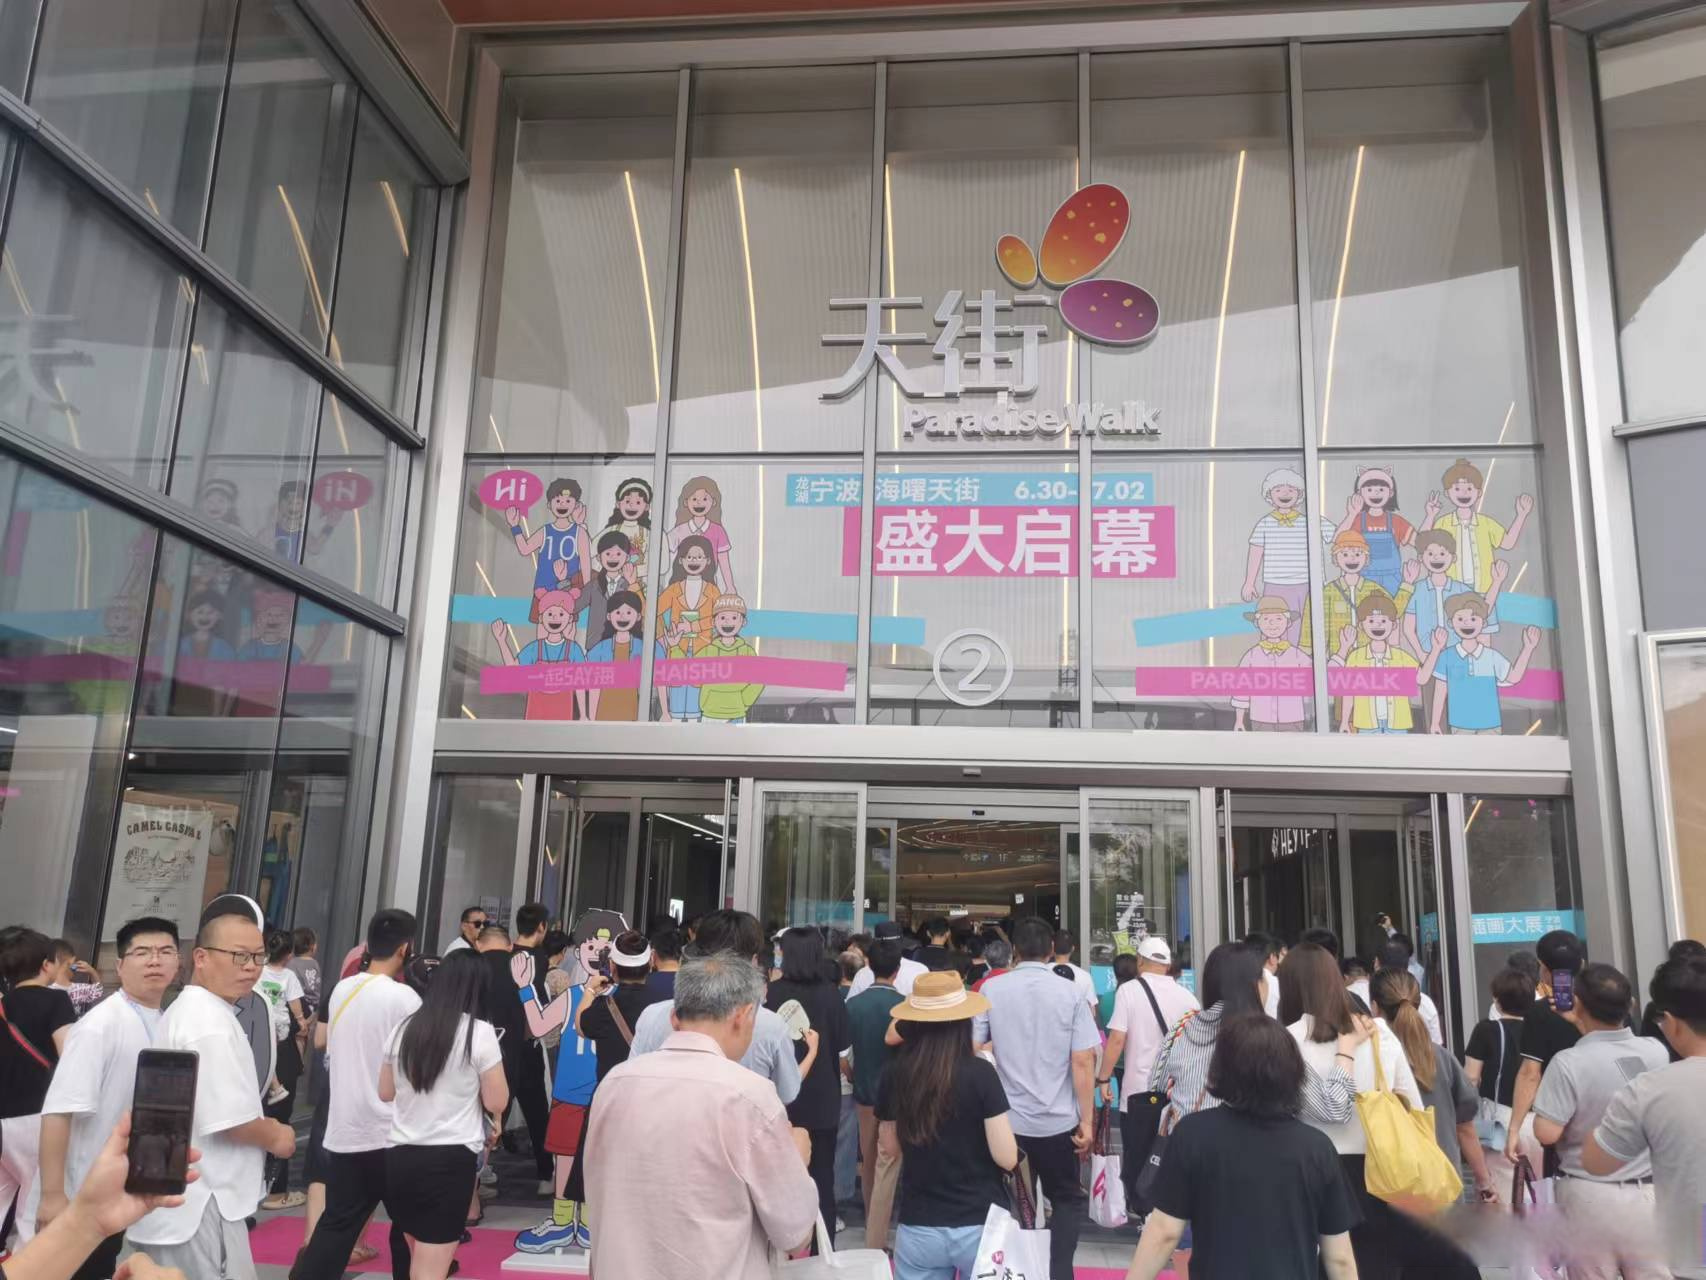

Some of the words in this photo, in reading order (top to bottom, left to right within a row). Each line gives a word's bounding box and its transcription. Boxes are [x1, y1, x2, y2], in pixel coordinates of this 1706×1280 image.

[819, 290, 1048, 399] 天街
[904, 399, 1057, 438] Paradise
[1066, 401, 1162, 437] Walk
[494, 478, 527, 500] Hi
[541, 536, 577, 561] 10
[876, 508, 1157, 575] 盛大启幕
[655, 663, 733, 681] HAISHU
[1191, 671, 1306, 691] PARADISE
[1328, 670, 1400, 691] WALK
[127, 821, 163, 836] CAMEL
